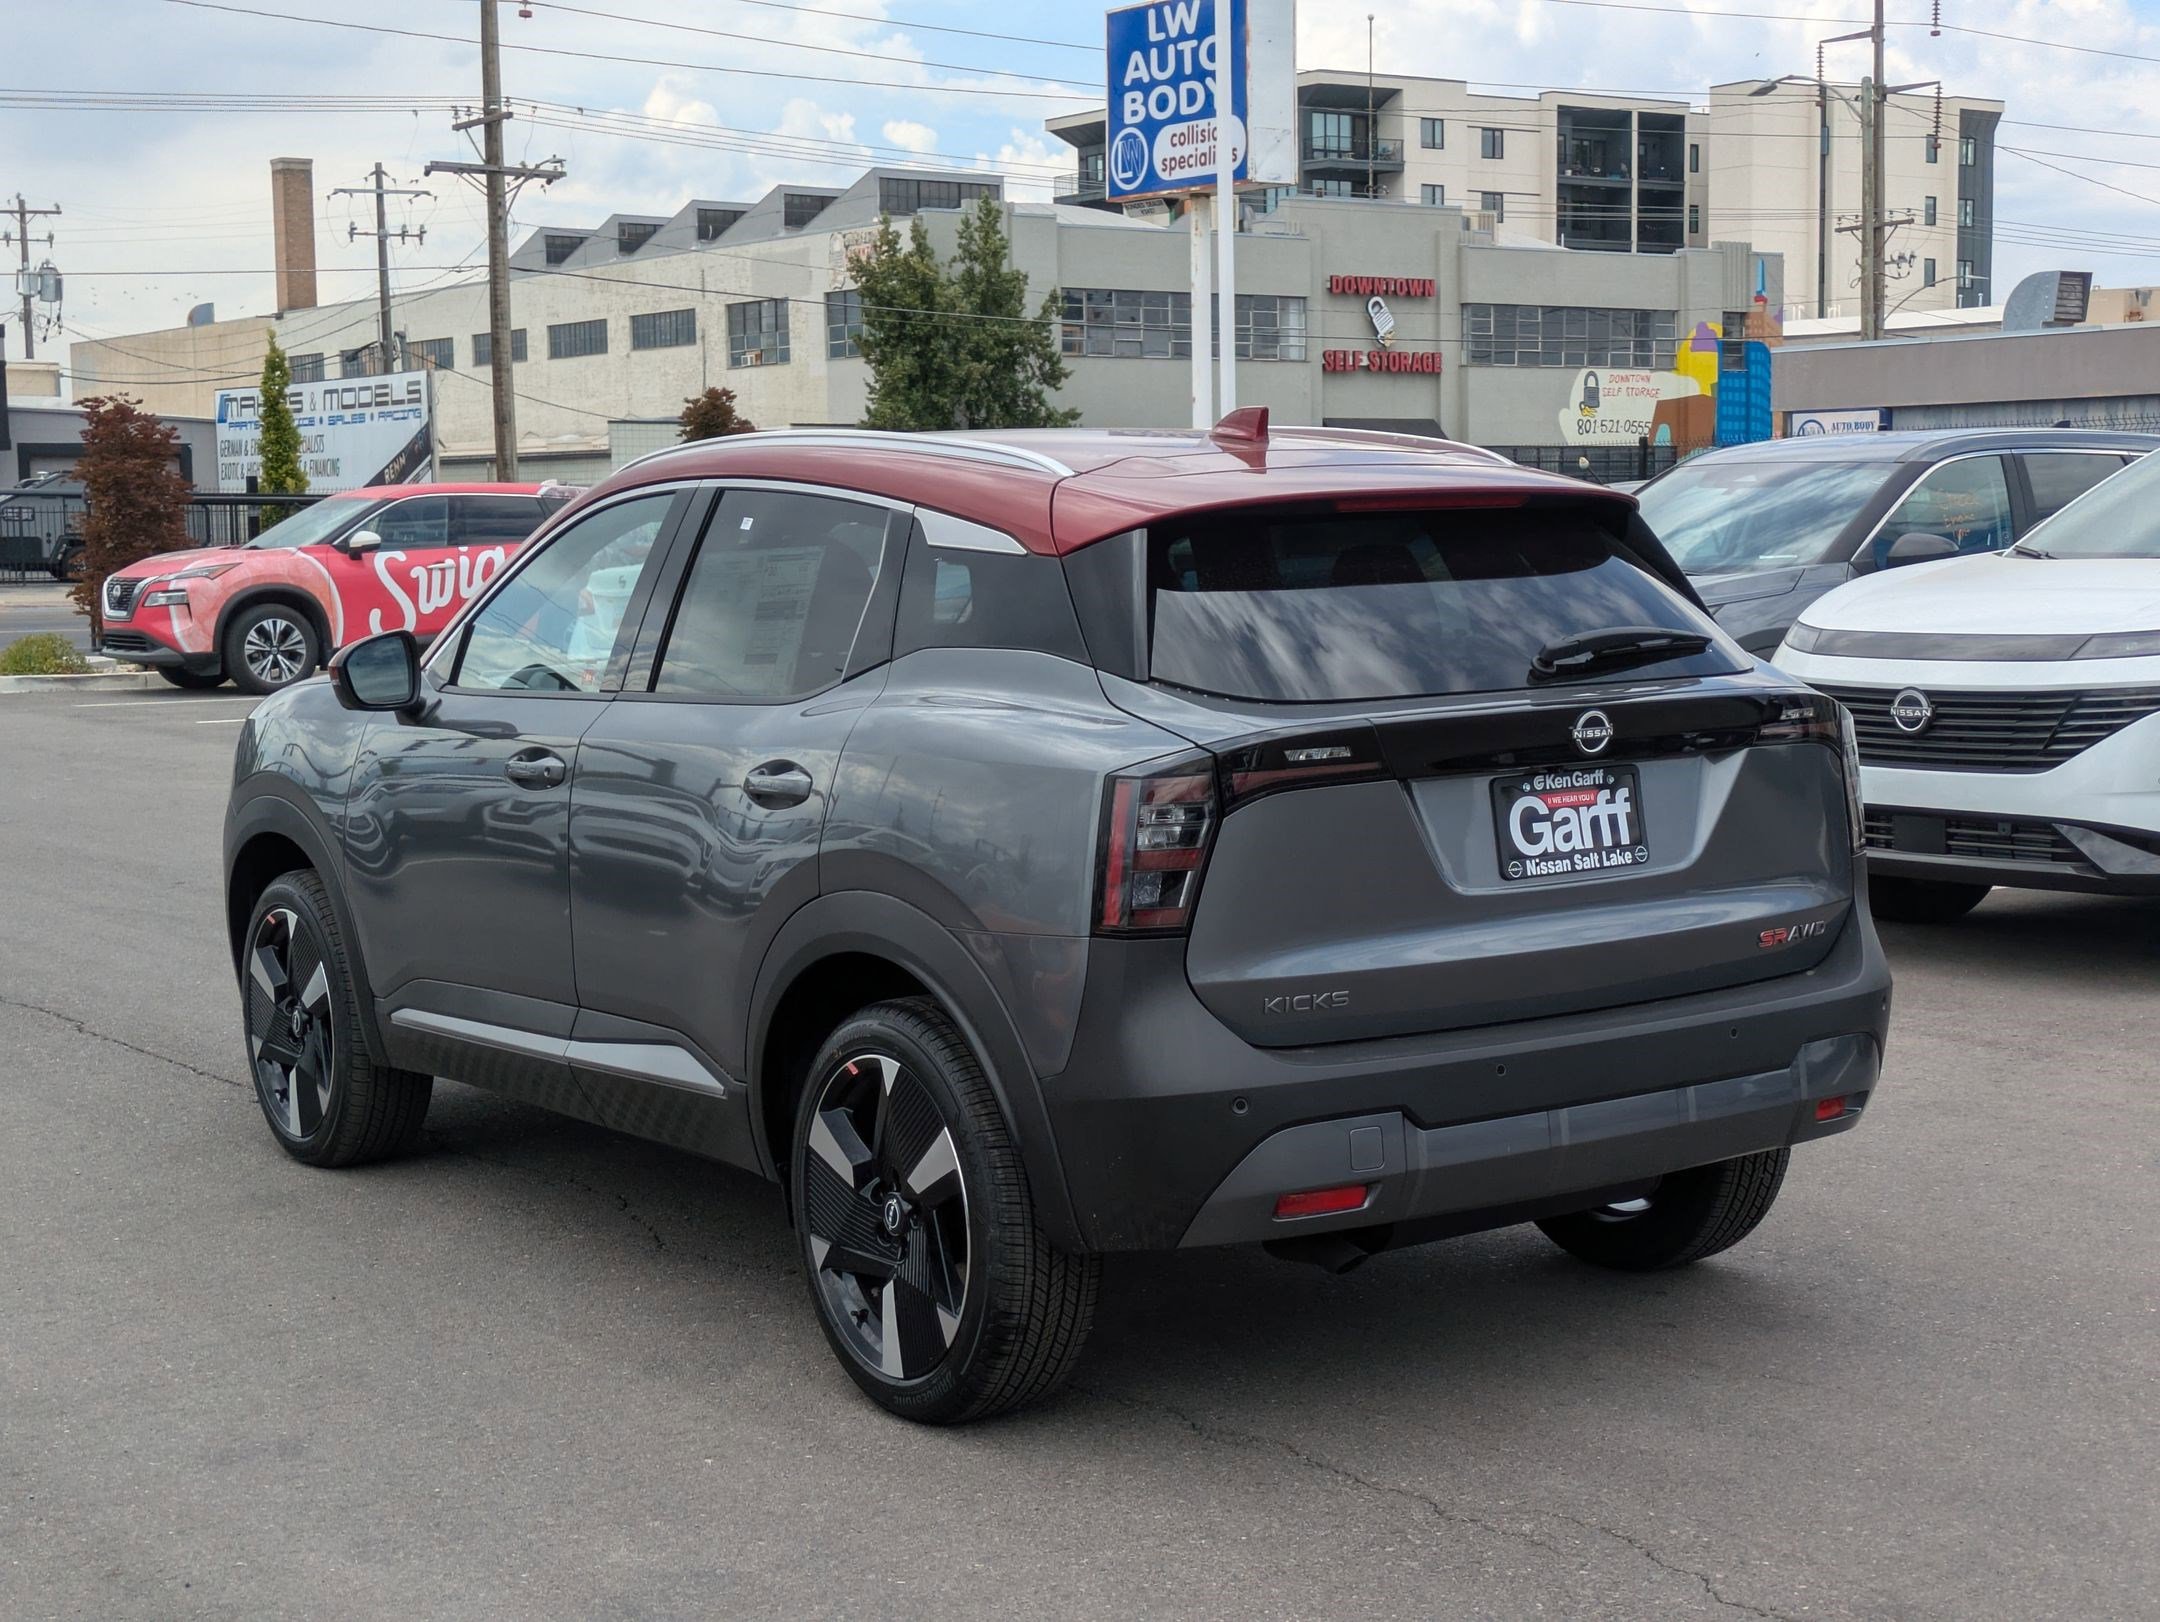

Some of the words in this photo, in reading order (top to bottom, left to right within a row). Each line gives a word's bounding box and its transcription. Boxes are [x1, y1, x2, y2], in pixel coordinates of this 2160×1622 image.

[1147, 0, 1200, 42] LW
[1170, 122, 1218, 148] collisio
[1161, 144, 1238, 177] specialis
[1329, 274, 1436, 298] DOWNTOWN
[1322, 350, 1363, 373] SELF
[1367, 350, 1442, 374] STORAGE
[1608, 373, 1652, 384] DOWNTOWN
[224, 391, 303, 417] MAS
[310, 391, 317, 412] &
[323, 379, 422, 412] MODELS
[1602, 386, 1622, 397] SELF
[1625, 386, 1660, 399] STORAGE
[328, 412, 366, 426] SALES
[220, 439, 243, 457] GERMAN
[309, 457, 340, 478] FINANCING
[1891, 706, 1932, 717] NISSAN
[1573, 727, 1613, 739] NISSAN
[1546, 773, 1571, 789] Ken
[1572, 769, 1604, 786] Garff
[1552, 796, 1562, 804] WE
[1563, 795, 1578, 803] HEAR
[1578, 793, 1590, 801] YOU
[1509, 787, 1631, 857] Garff
[1526, 858, 1572, 876] Nissan
[1574, 852, 1600, 867] Salt
[1602, 849, 1633, 866] Lake
[1264, 990, 1350, 1013] KICKS
